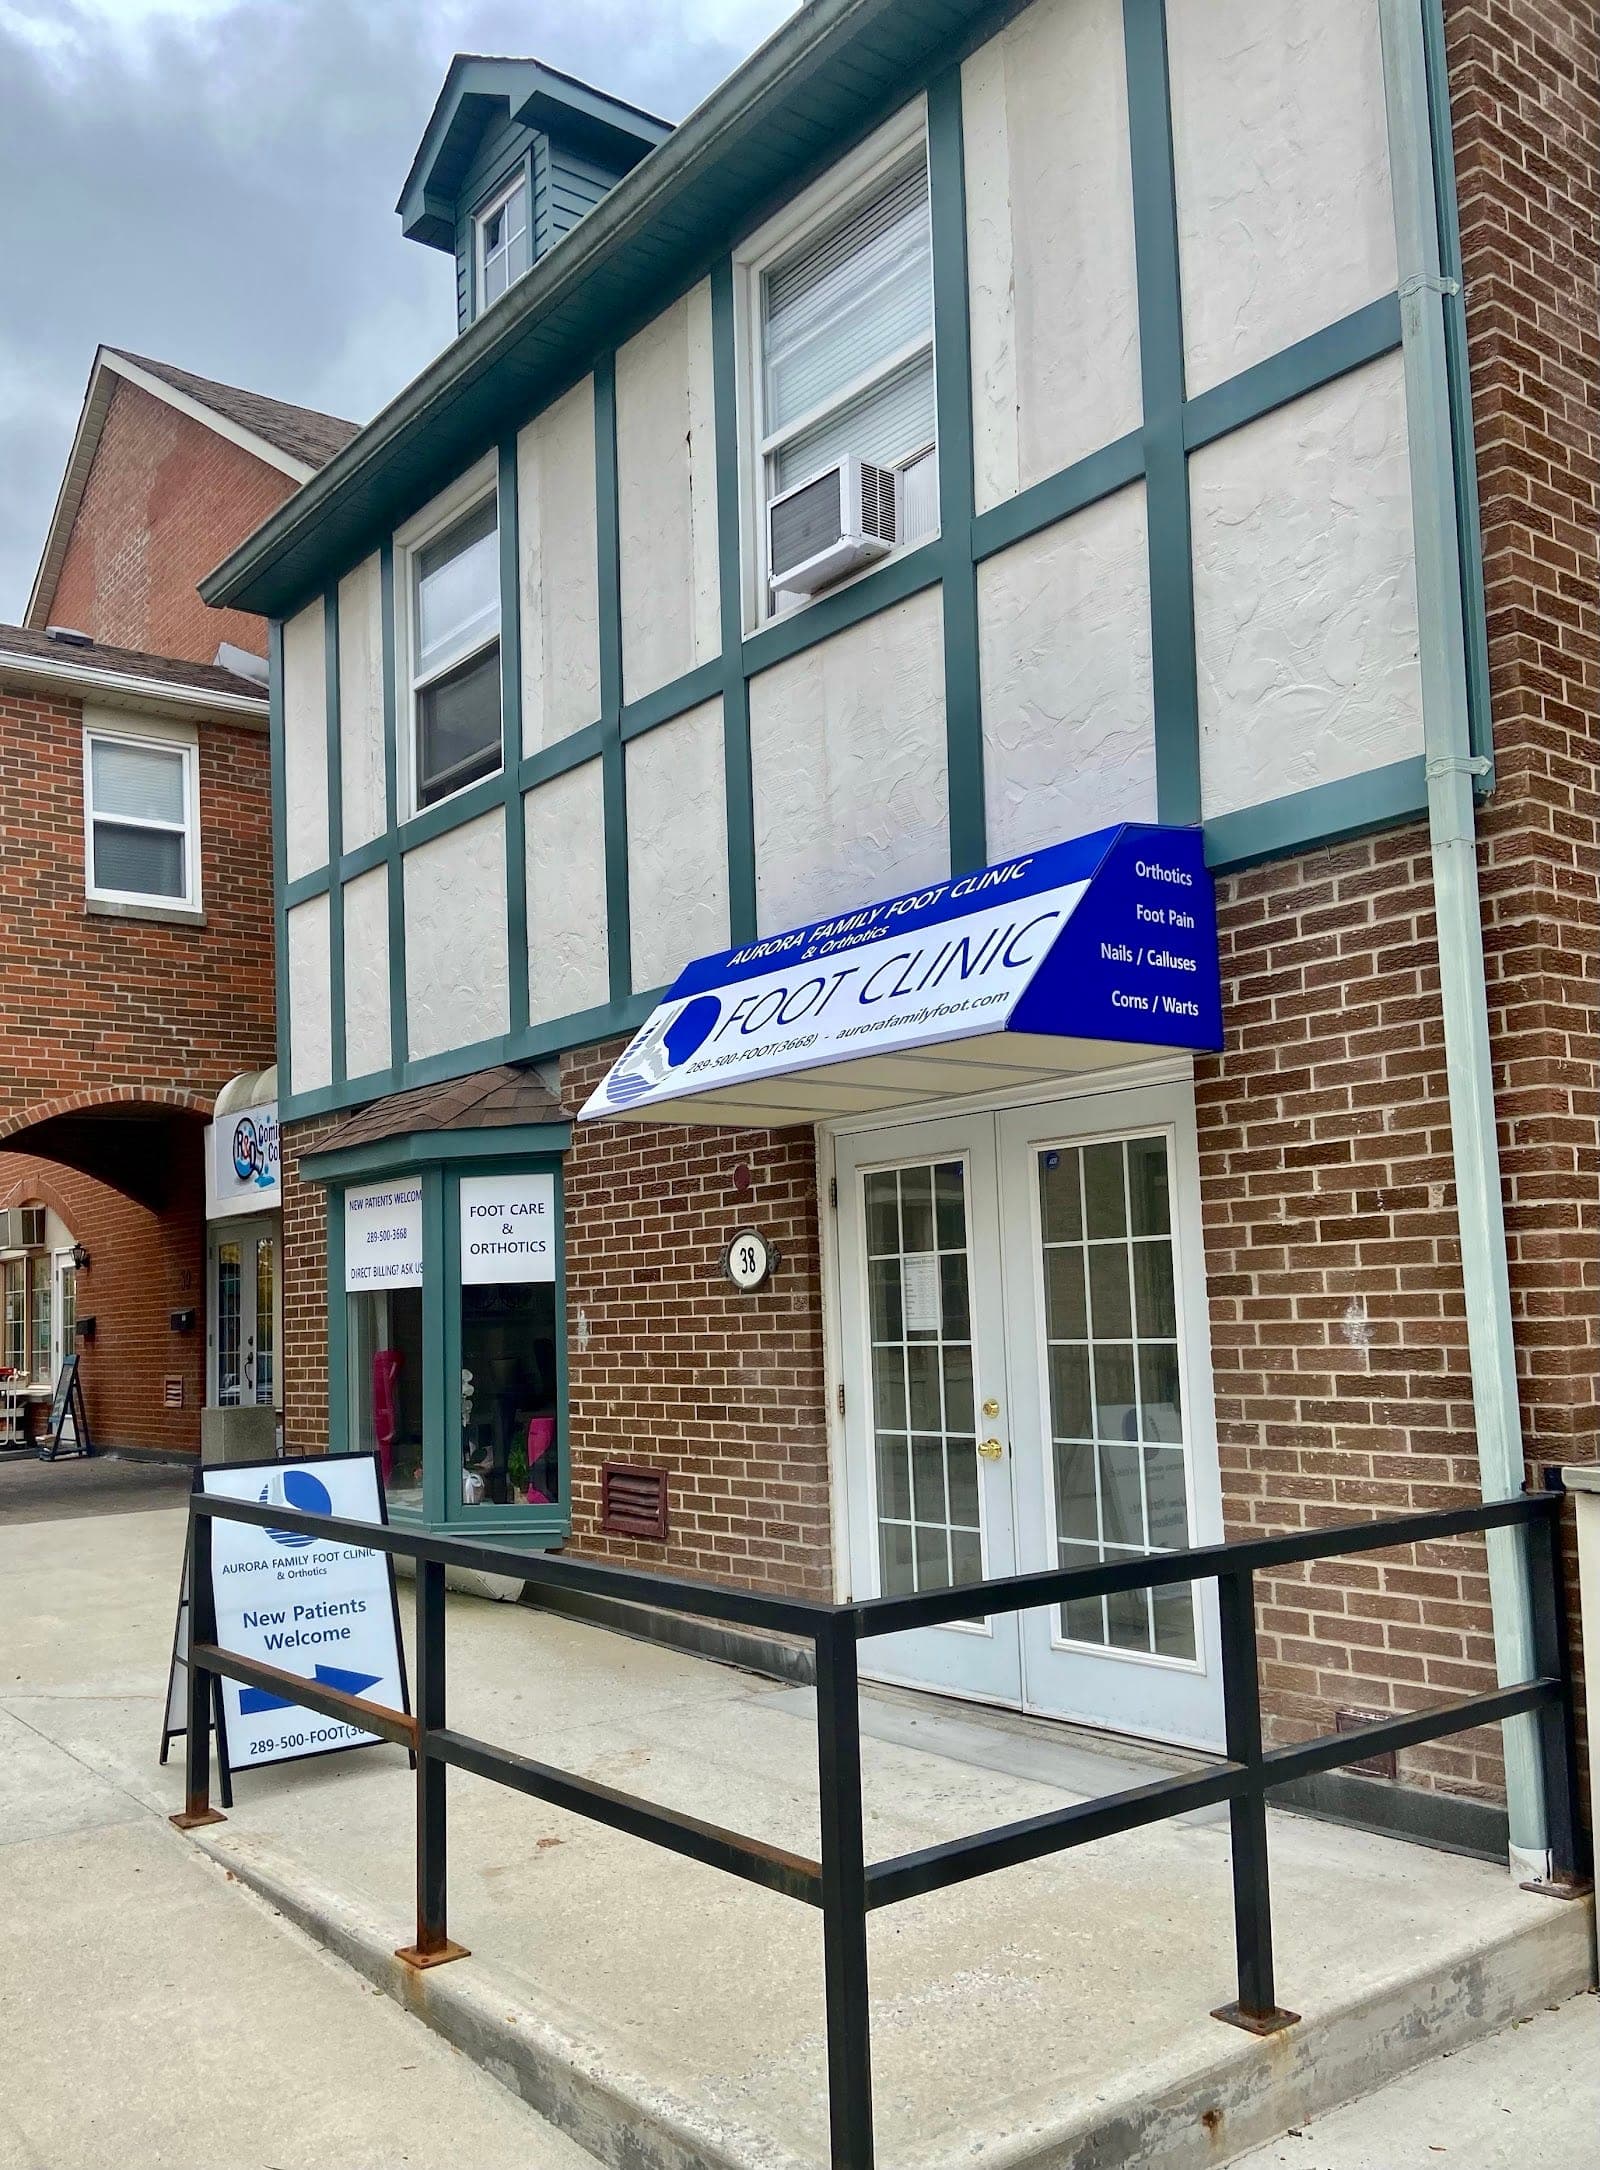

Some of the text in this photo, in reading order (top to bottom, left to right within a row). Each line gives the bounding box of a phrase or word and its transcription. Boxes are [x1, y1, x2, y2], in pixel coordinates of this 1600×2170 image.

[1135, 860, 1193, 886] Orthotics
[726, 859, 1034, 967] AURORA FAMILY FOOT CLINIC
[1136, 903, 1195, 929] Foot Pain
[801, 925, 889, 960] & Orthotics
[1100, 942, 1197, 971] Nails / Calluses
[712, 911, 1060, 1041] FOOT CLINIC
[1111, 990, 1199, 1016] Corns / Warts
[685, 1033, 819, 1074] 289-500-FOOT(3668)
[835, 990, 1010, 1039] aurorafamilyfoot.com
[349, 1200, 364, 1211] NEW
[365, 1194, 393, 1209] PATIENTS
[470, 1202, 545, 1218] FOOT CARE
[502, 1223, 513, 1235] &
[470, 1240, 546, 1255] ORTHOTICS
[740, 1247, 756, 1274] 38
[351, 1261, 424, 1279] DIRECT BILLING? ASK US
[222, 1548, 376, 1575] AURORA FAMILY FOOT CLINIC
[277, 1566, 327, 1580] & Orthotics
[243, 1598, 367, 1628] New Patients
[264, 1626, 351, 1650] Welcome
